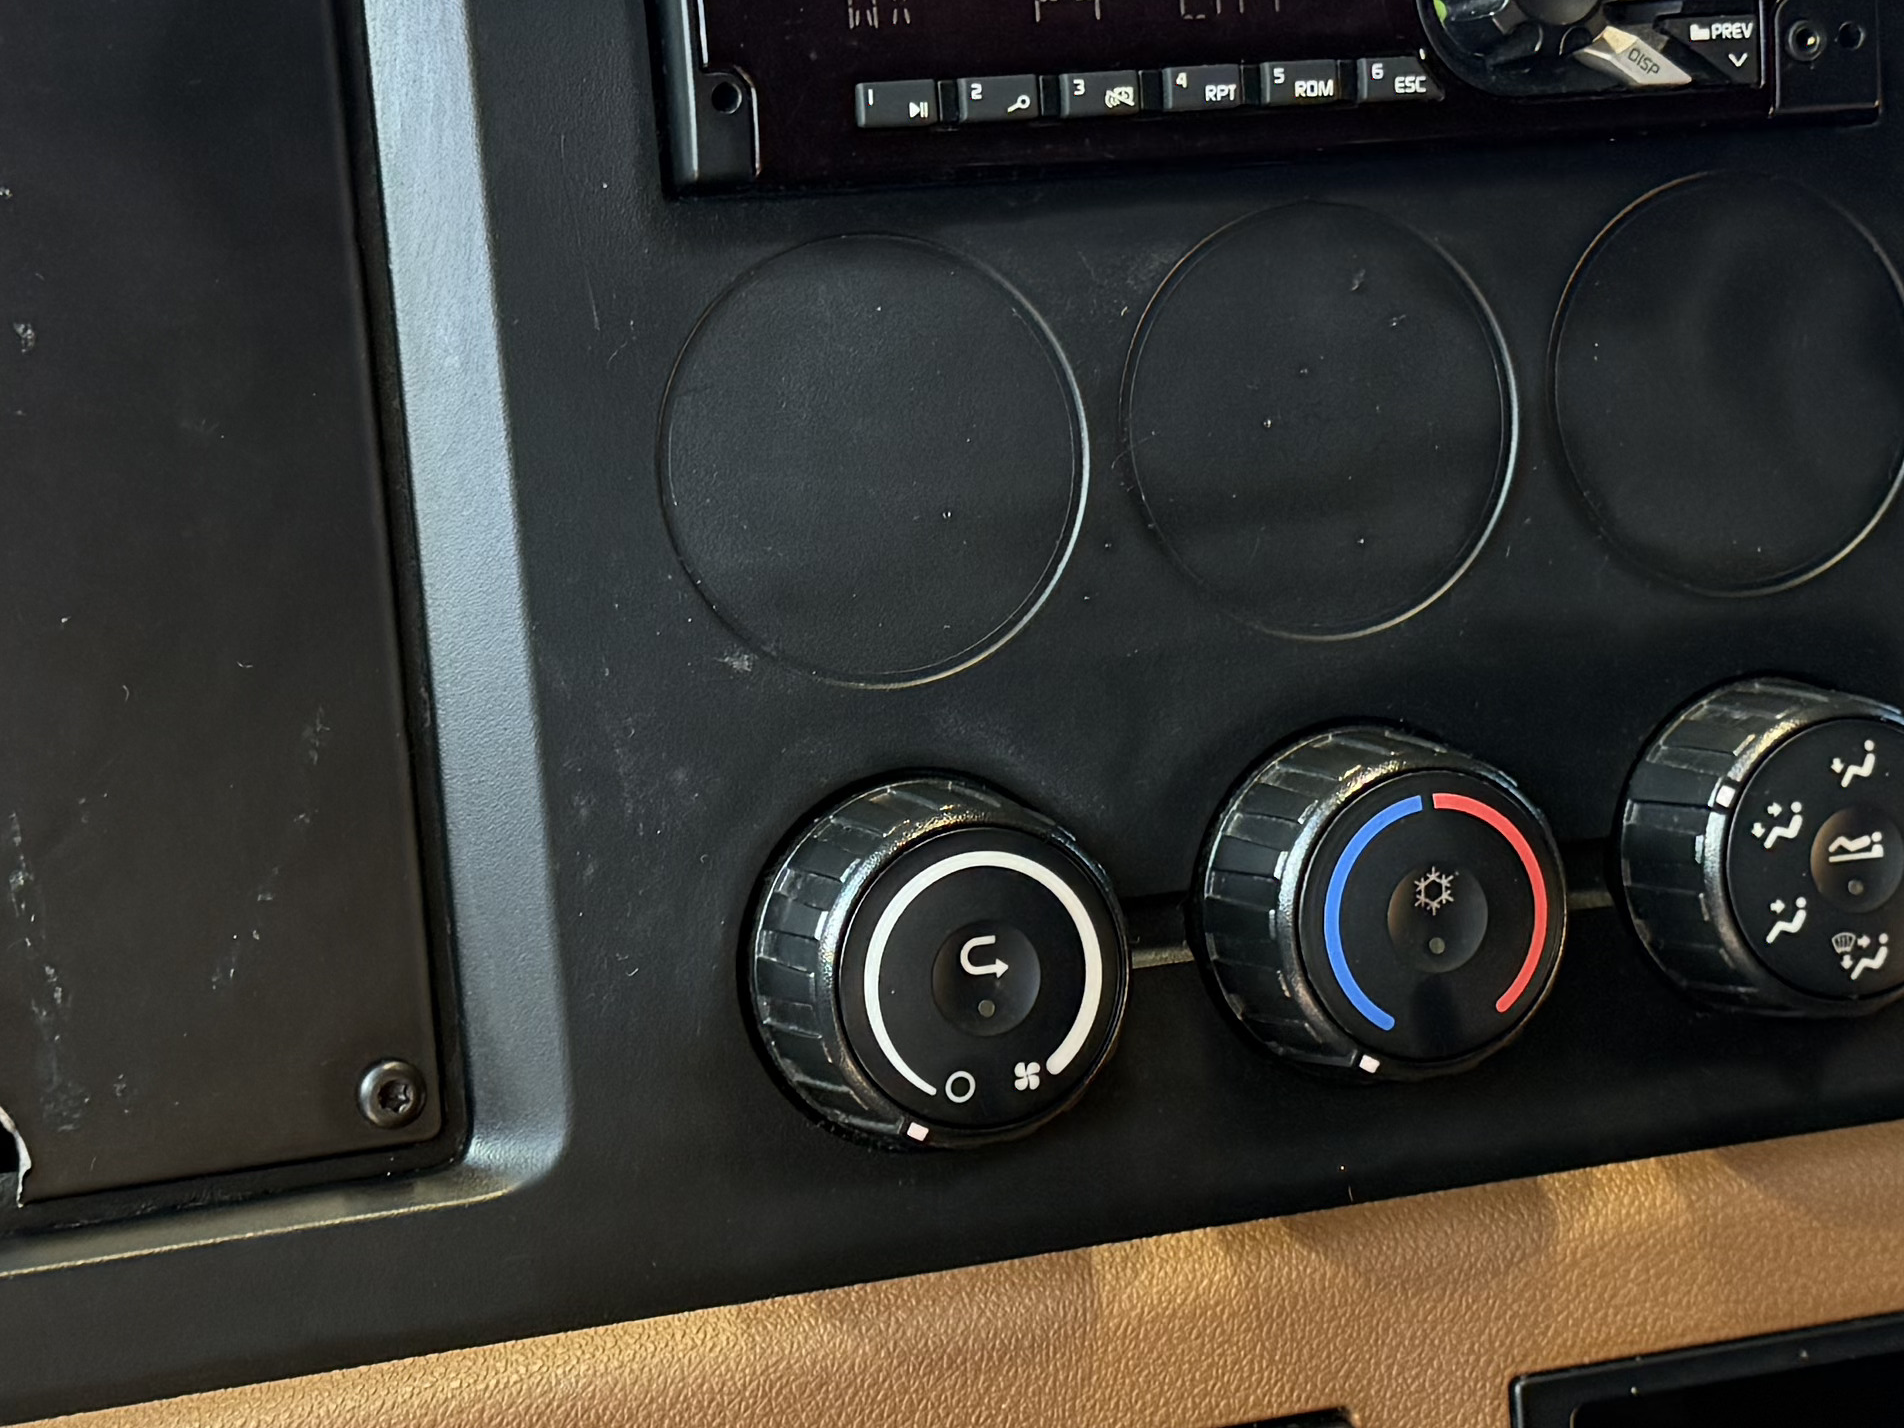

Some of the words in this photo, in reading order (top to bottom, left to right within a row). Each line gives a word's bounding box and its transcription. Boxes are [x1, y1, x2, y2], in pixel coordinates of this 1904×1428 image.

[1711, 22, 1754, 40] PREV
[1627, 47, 1660, 75] DISP
[1273, 67, 1285, 84] 5
[1371, 63, 1384, 80] 6
[1394, 75, 1427, 94] ESC
[970, 83, 983, 100] 2
[1072, 78, 1086, 96] 3
[1175, 72, 1188, 89] 4
[1205, 84, 1237, 102] RPT
